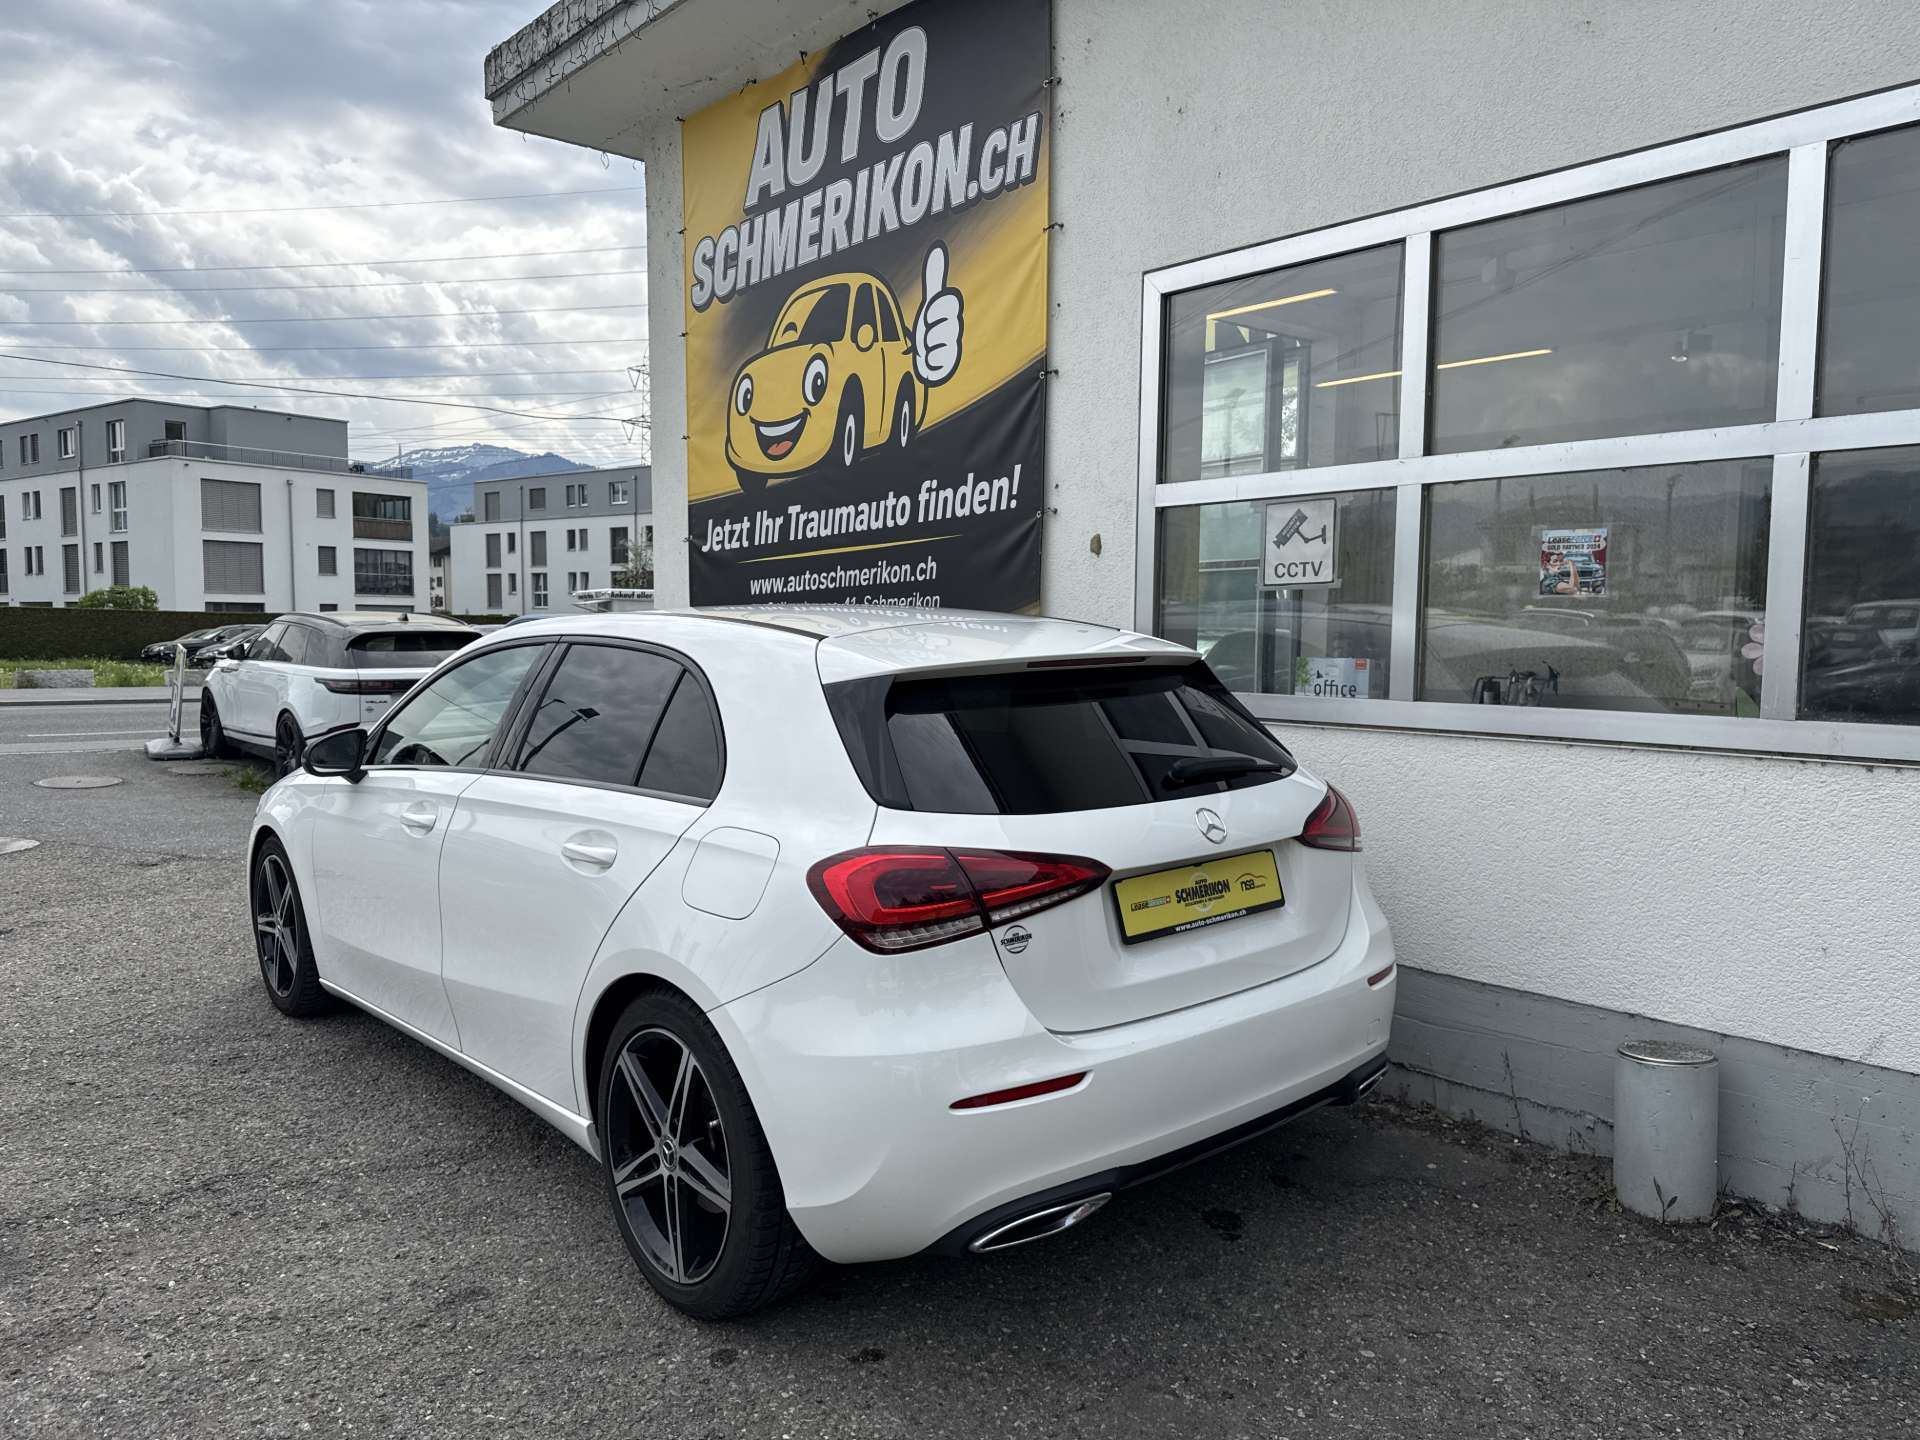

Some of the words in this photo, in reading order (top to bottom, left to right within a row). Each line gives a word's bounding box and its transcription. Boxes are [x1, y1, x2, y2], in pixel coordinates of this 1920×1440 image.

[743, 24, 928, 210] AUTO
[690, 112, 1041, 309] SCHMERIKON.CH
[701, 516, 750, 553] Jetzt
[753, 511, 784, 546] Ihr
[787, 491, 911, 541] Traumauto
[917, 464, 1022, 523] finden!
[750, 555, 937, 596] www.autoschmerikon.ch
[1274, 560, 1323, 578] CCTV
[1314, 679, 1357, 698] office
[1175, 879, 1231, 903] SCHMERIKON
